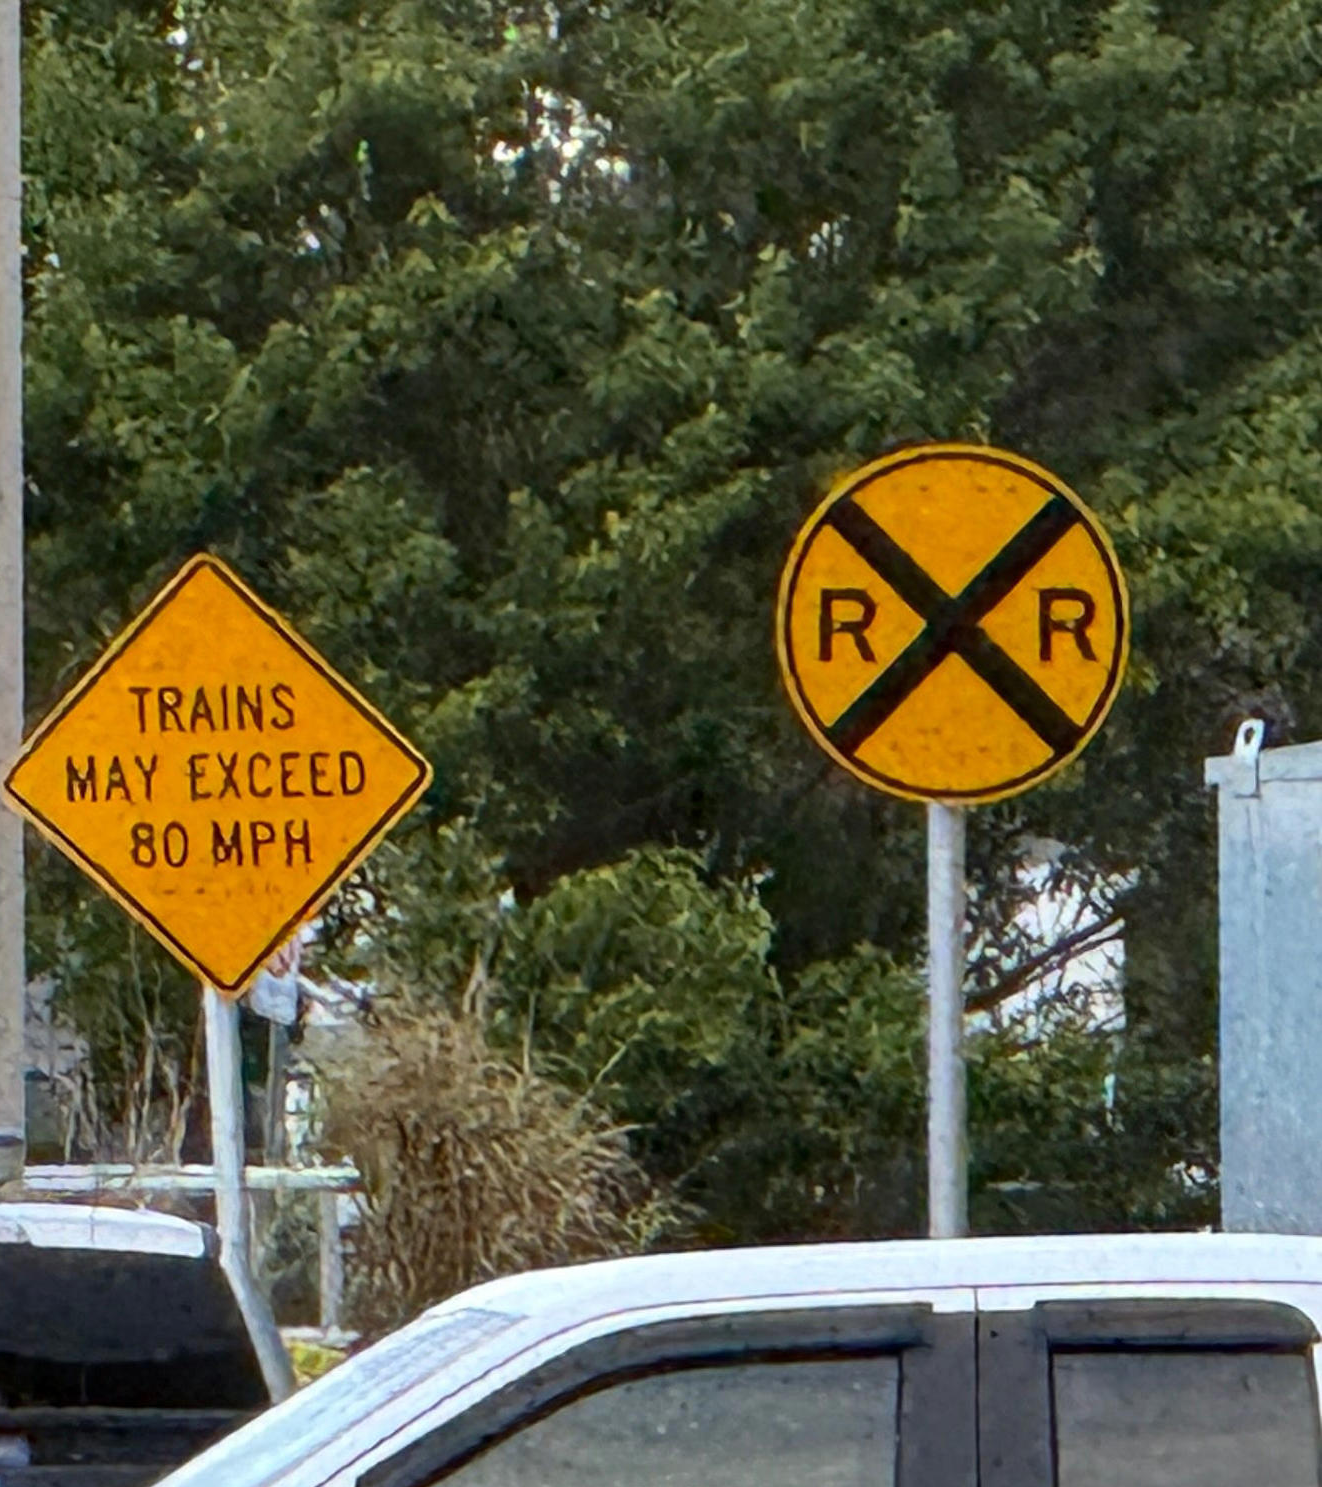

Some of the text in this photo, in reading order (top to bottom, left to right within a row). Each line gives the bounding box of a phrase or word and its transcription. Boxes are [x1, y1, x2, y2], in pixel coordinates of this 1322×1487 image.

[817, 588, 1098, 663] R R
[128, 682, 295, 733] TRAINS
[65, 751, 367, 805] MAY EXCEED
[130, 819, 314, 869] 80 MPH
